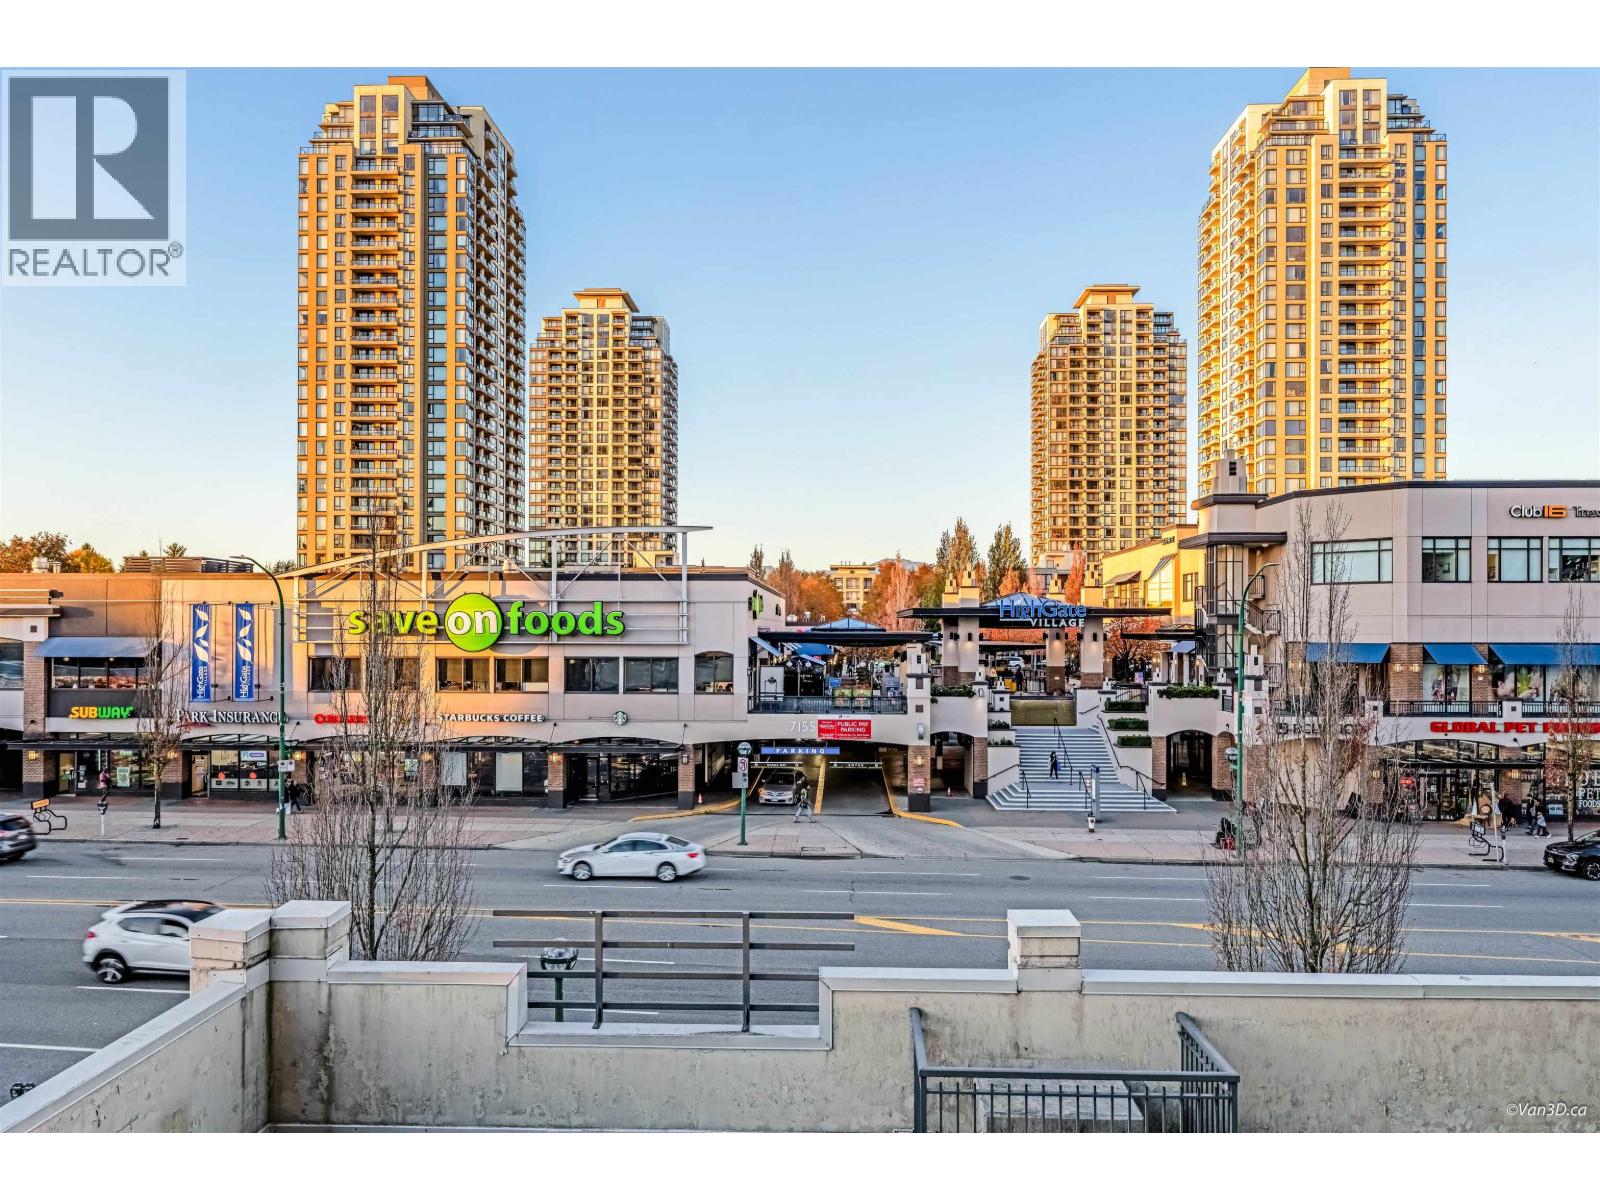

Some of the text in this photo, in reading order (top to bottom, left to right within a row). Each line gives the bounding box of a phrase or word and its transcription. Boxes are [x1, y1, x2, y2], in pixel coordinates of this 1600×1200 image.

[1000, 600, 1087, 620] HighGate
[348, 601, 625, 635] save on foods
[1030, 618, 1085, 627] VILLAGE
[69, 706, 135, 719] SUBWAY
[176, 708, 209, 723] PARK
[438, 713, 545, 722] STARBUCKS COFFEE
[790, 721, 816, 732] 7155
[1430, 721, 1498, 733] GLOBAL
[1504, 722, 1537, 733] PET
